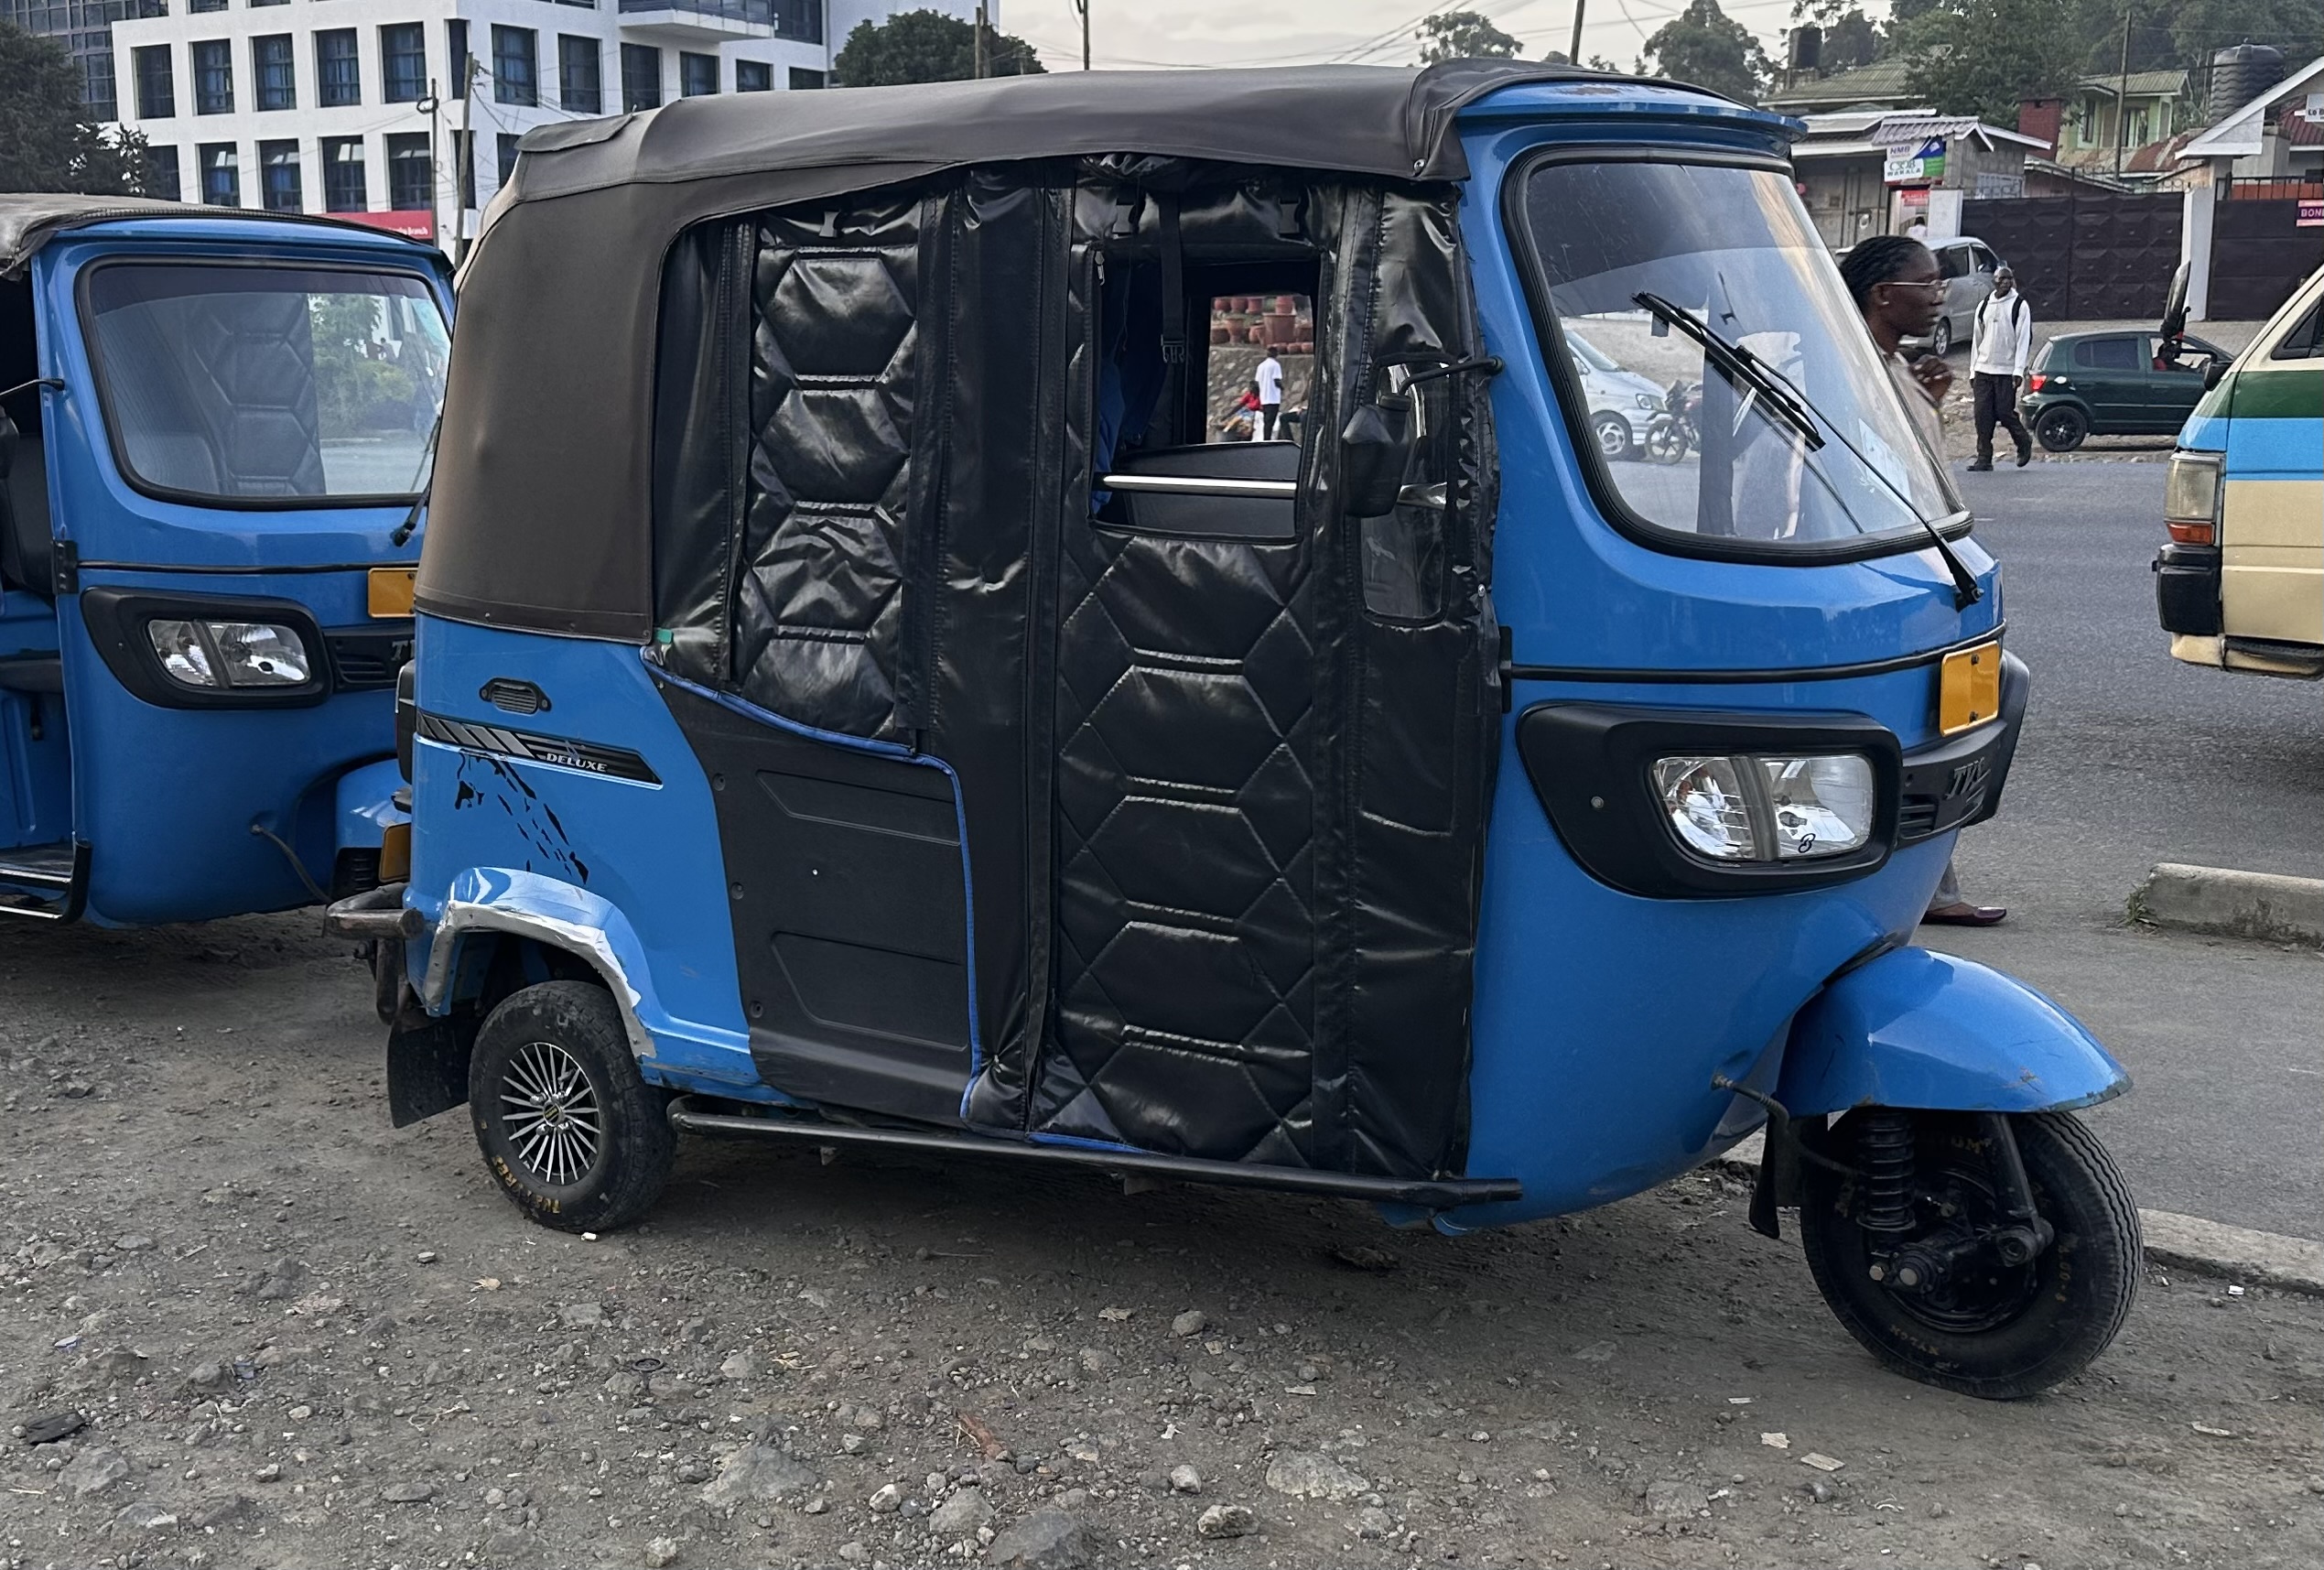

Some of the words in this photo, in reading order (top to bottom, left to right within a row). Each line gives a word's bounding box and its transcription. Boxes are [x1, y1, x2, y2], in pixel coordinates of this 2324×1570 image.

[1886, 168, 1920, 176] WAKALA
[2300, 209, 2324, 217] BON
[546, 753, 608, 772] DELUXE
